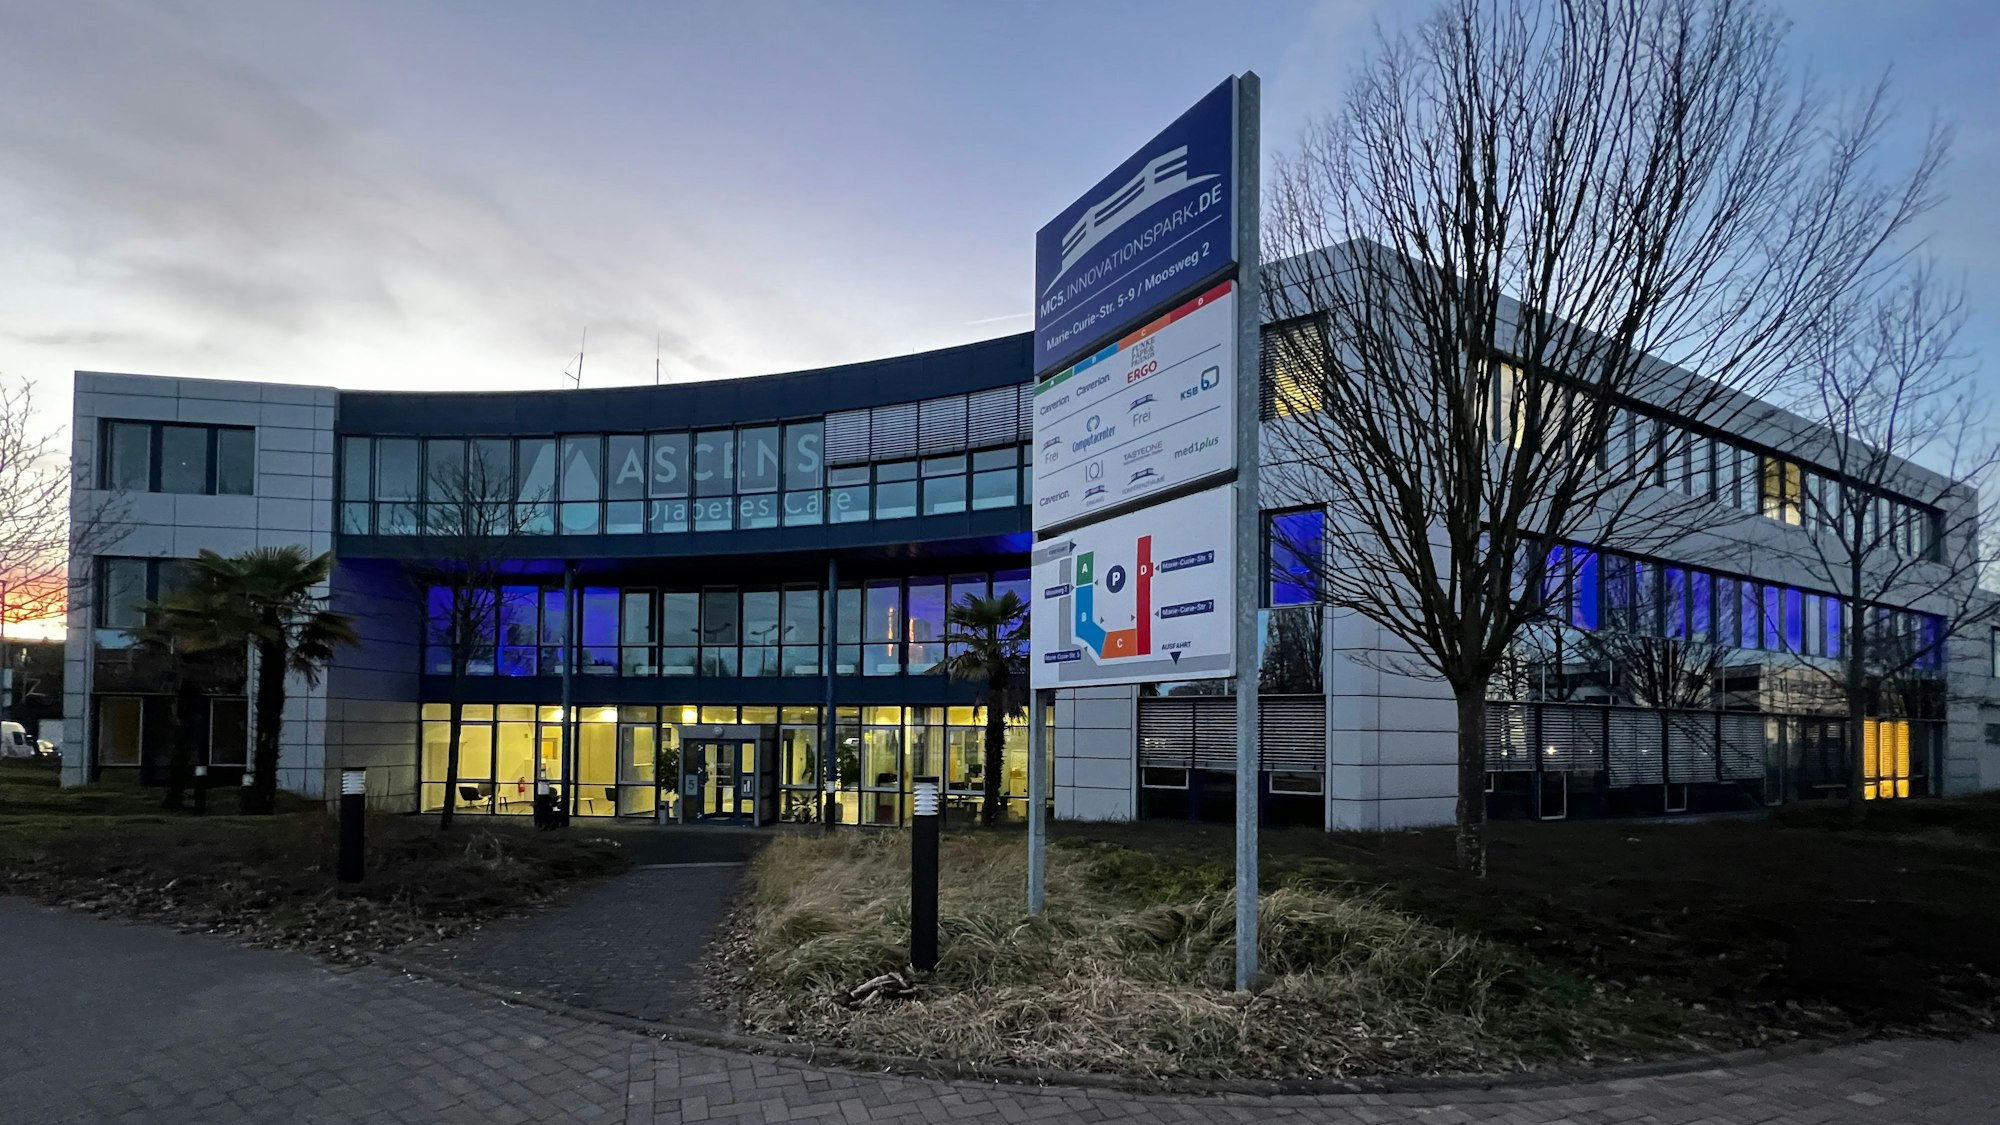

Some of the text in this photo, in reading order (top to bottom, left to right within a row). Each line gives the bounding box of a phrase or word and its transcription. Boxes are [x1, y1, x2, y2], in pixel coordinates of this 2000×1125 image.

[1040, 183, 1222, 318] MC5.INNOVATIONSPARK.DE
[1046, 305, 1115, 351] Marie-Curie-Str.
[1117, 287, 1135, 308] 5-9
[1145, 250, 1199, 287] Moosweg
[1201, 242, 1210, 257] 2
[1198, 297, 1203, 305] D
[1127, 360, 1157, 384] ERGO
[1076, 372, 1110, 396] Caverion
[1180, 386, 1198, 401] KSB
[1040, 394, 1070, 416] Caverion
[1133, 408, 1151, 427] Frei
[1072, 425, 1115, 453] Computacenter
[1174, 435, 1219, 459] med1plus
[1045, 451, 1059, 465] Frei
[1040, 489, 1069, 507] Caverion
[648, 491, 851, 521] Diabetes Cae
[1208, 553, 1213, 561] 9
[1082, 564, 1088, 574] A
[1141, 565, 1147, 575] D
[1112, 572, 1120, 586] P
[1082, 612, 1087, 622] B
[1117, 638, 1123, 648] C
[1162, 641, 1191, 651] AUSFAHRT
[688, 780, 694, 790] 5
